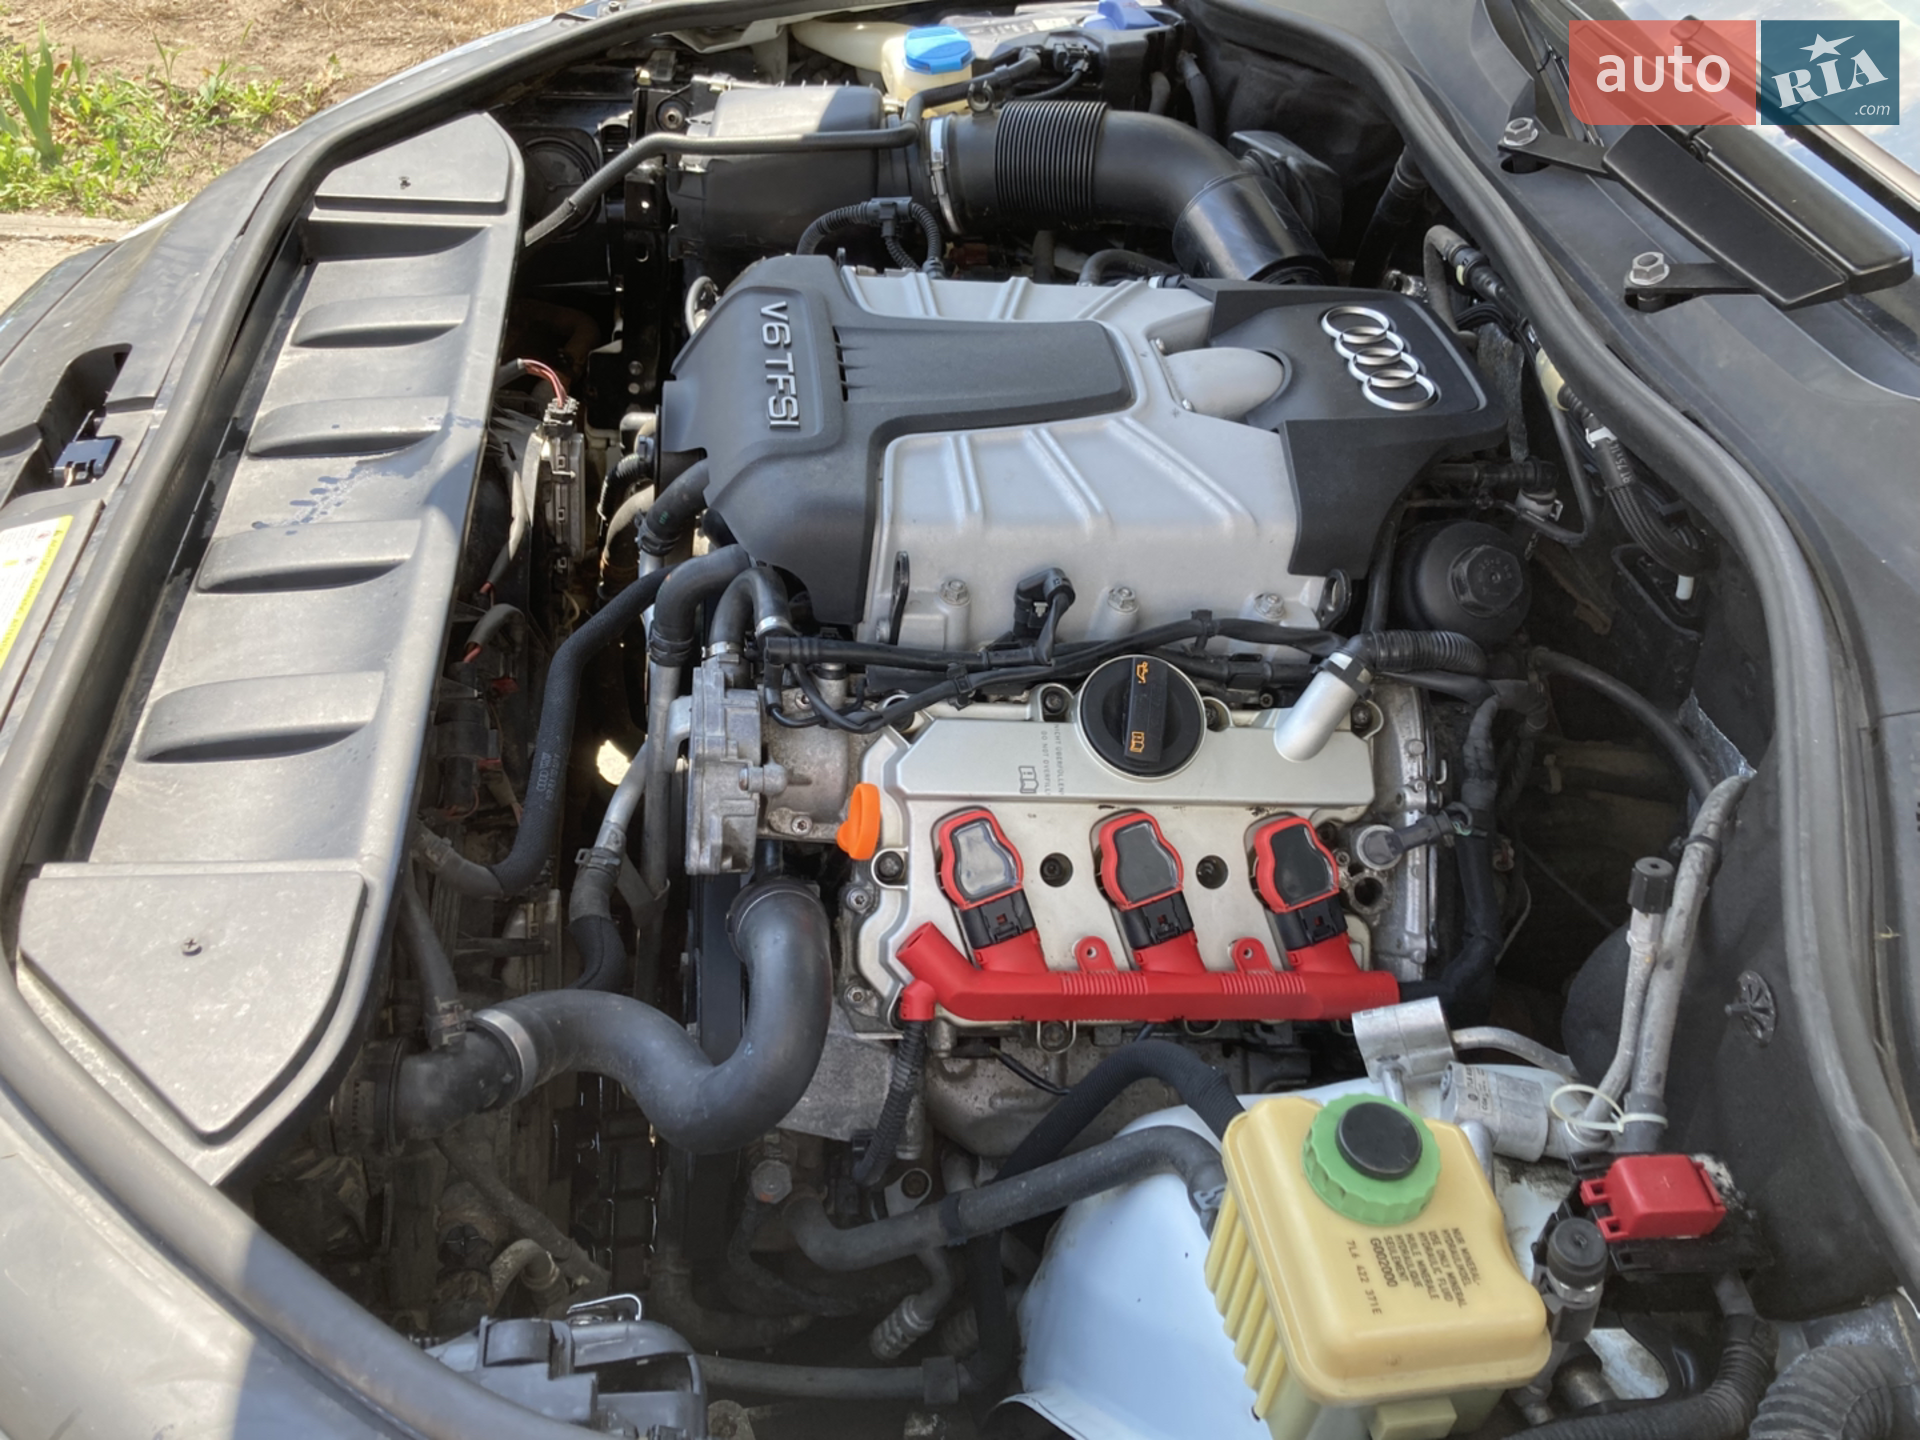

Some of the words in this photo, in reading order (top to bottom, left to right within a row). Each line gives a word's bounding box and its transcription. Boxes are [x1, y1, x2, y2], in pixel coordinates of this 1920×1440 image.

[761, 300, 792, 346] V6
[765, 352, 800, 427] TFSI
[1383, 1235, 1410, 1283] SEULEMENT
[1405, 1233, 1422, 1257] HUILE
[1451, 1227, 1466, 1245] NUR
[1356, 1264, 1370, 1284] 422
[1394, 1234, 1424, 1288] HYDRAULIQUE
[1418, 1231, 1443, 1275] HYDRAULIC
[1437, 1277, 1454, 1302] FLUID
[1428, 1230, 1442, 1247] USE
[1436, 1248, 1453, 1269] ONLY
[1445, 1271, 1468, 1309] MINERAL
